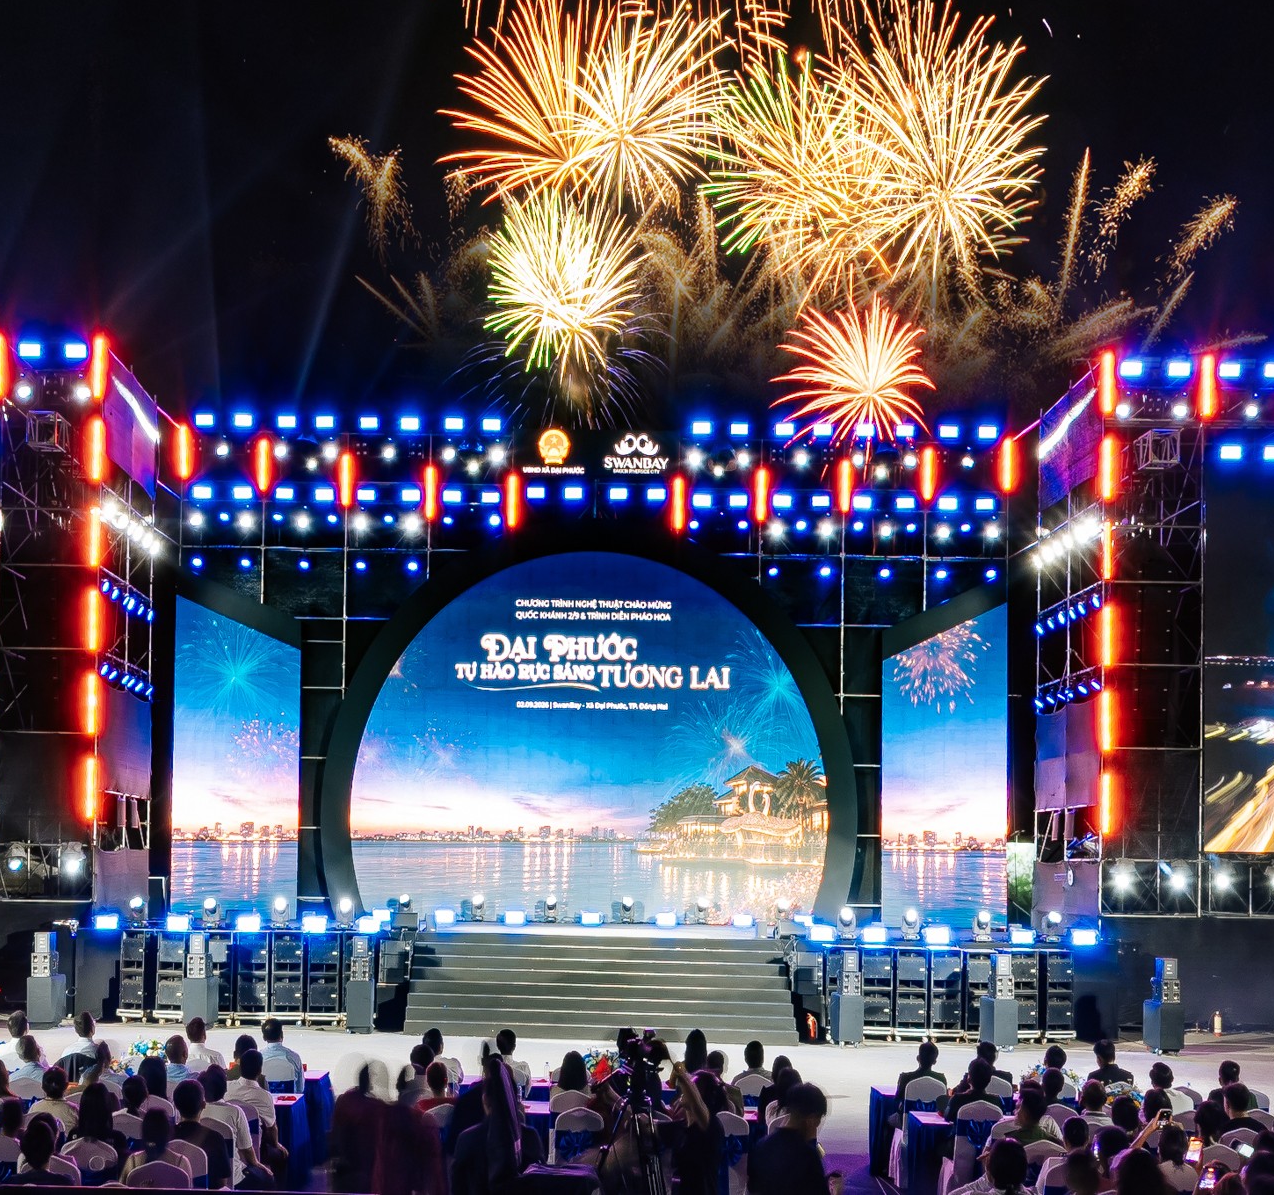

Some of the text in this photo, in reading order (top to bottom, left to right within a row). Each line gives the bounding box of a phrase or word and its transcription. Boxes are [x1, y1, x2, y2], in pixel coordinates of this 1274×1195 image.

[604, 457, 669, 470] SWANBAY
[515, 598, 672, 610] CHƯƠNG TRÌNH NGHỆ THUẬT CHÀO MỪNG
[515, 609, 672, 622] QUỐC KHÁNH 2/9 & TRÌNH DIỄN PHÁO HOA
[480, 632, 638, 663] ĐẠI PHƯỚC
[455, 660, 731, 690] TỰ HÀO RỰC SÁNG TƯƠNG LAI
